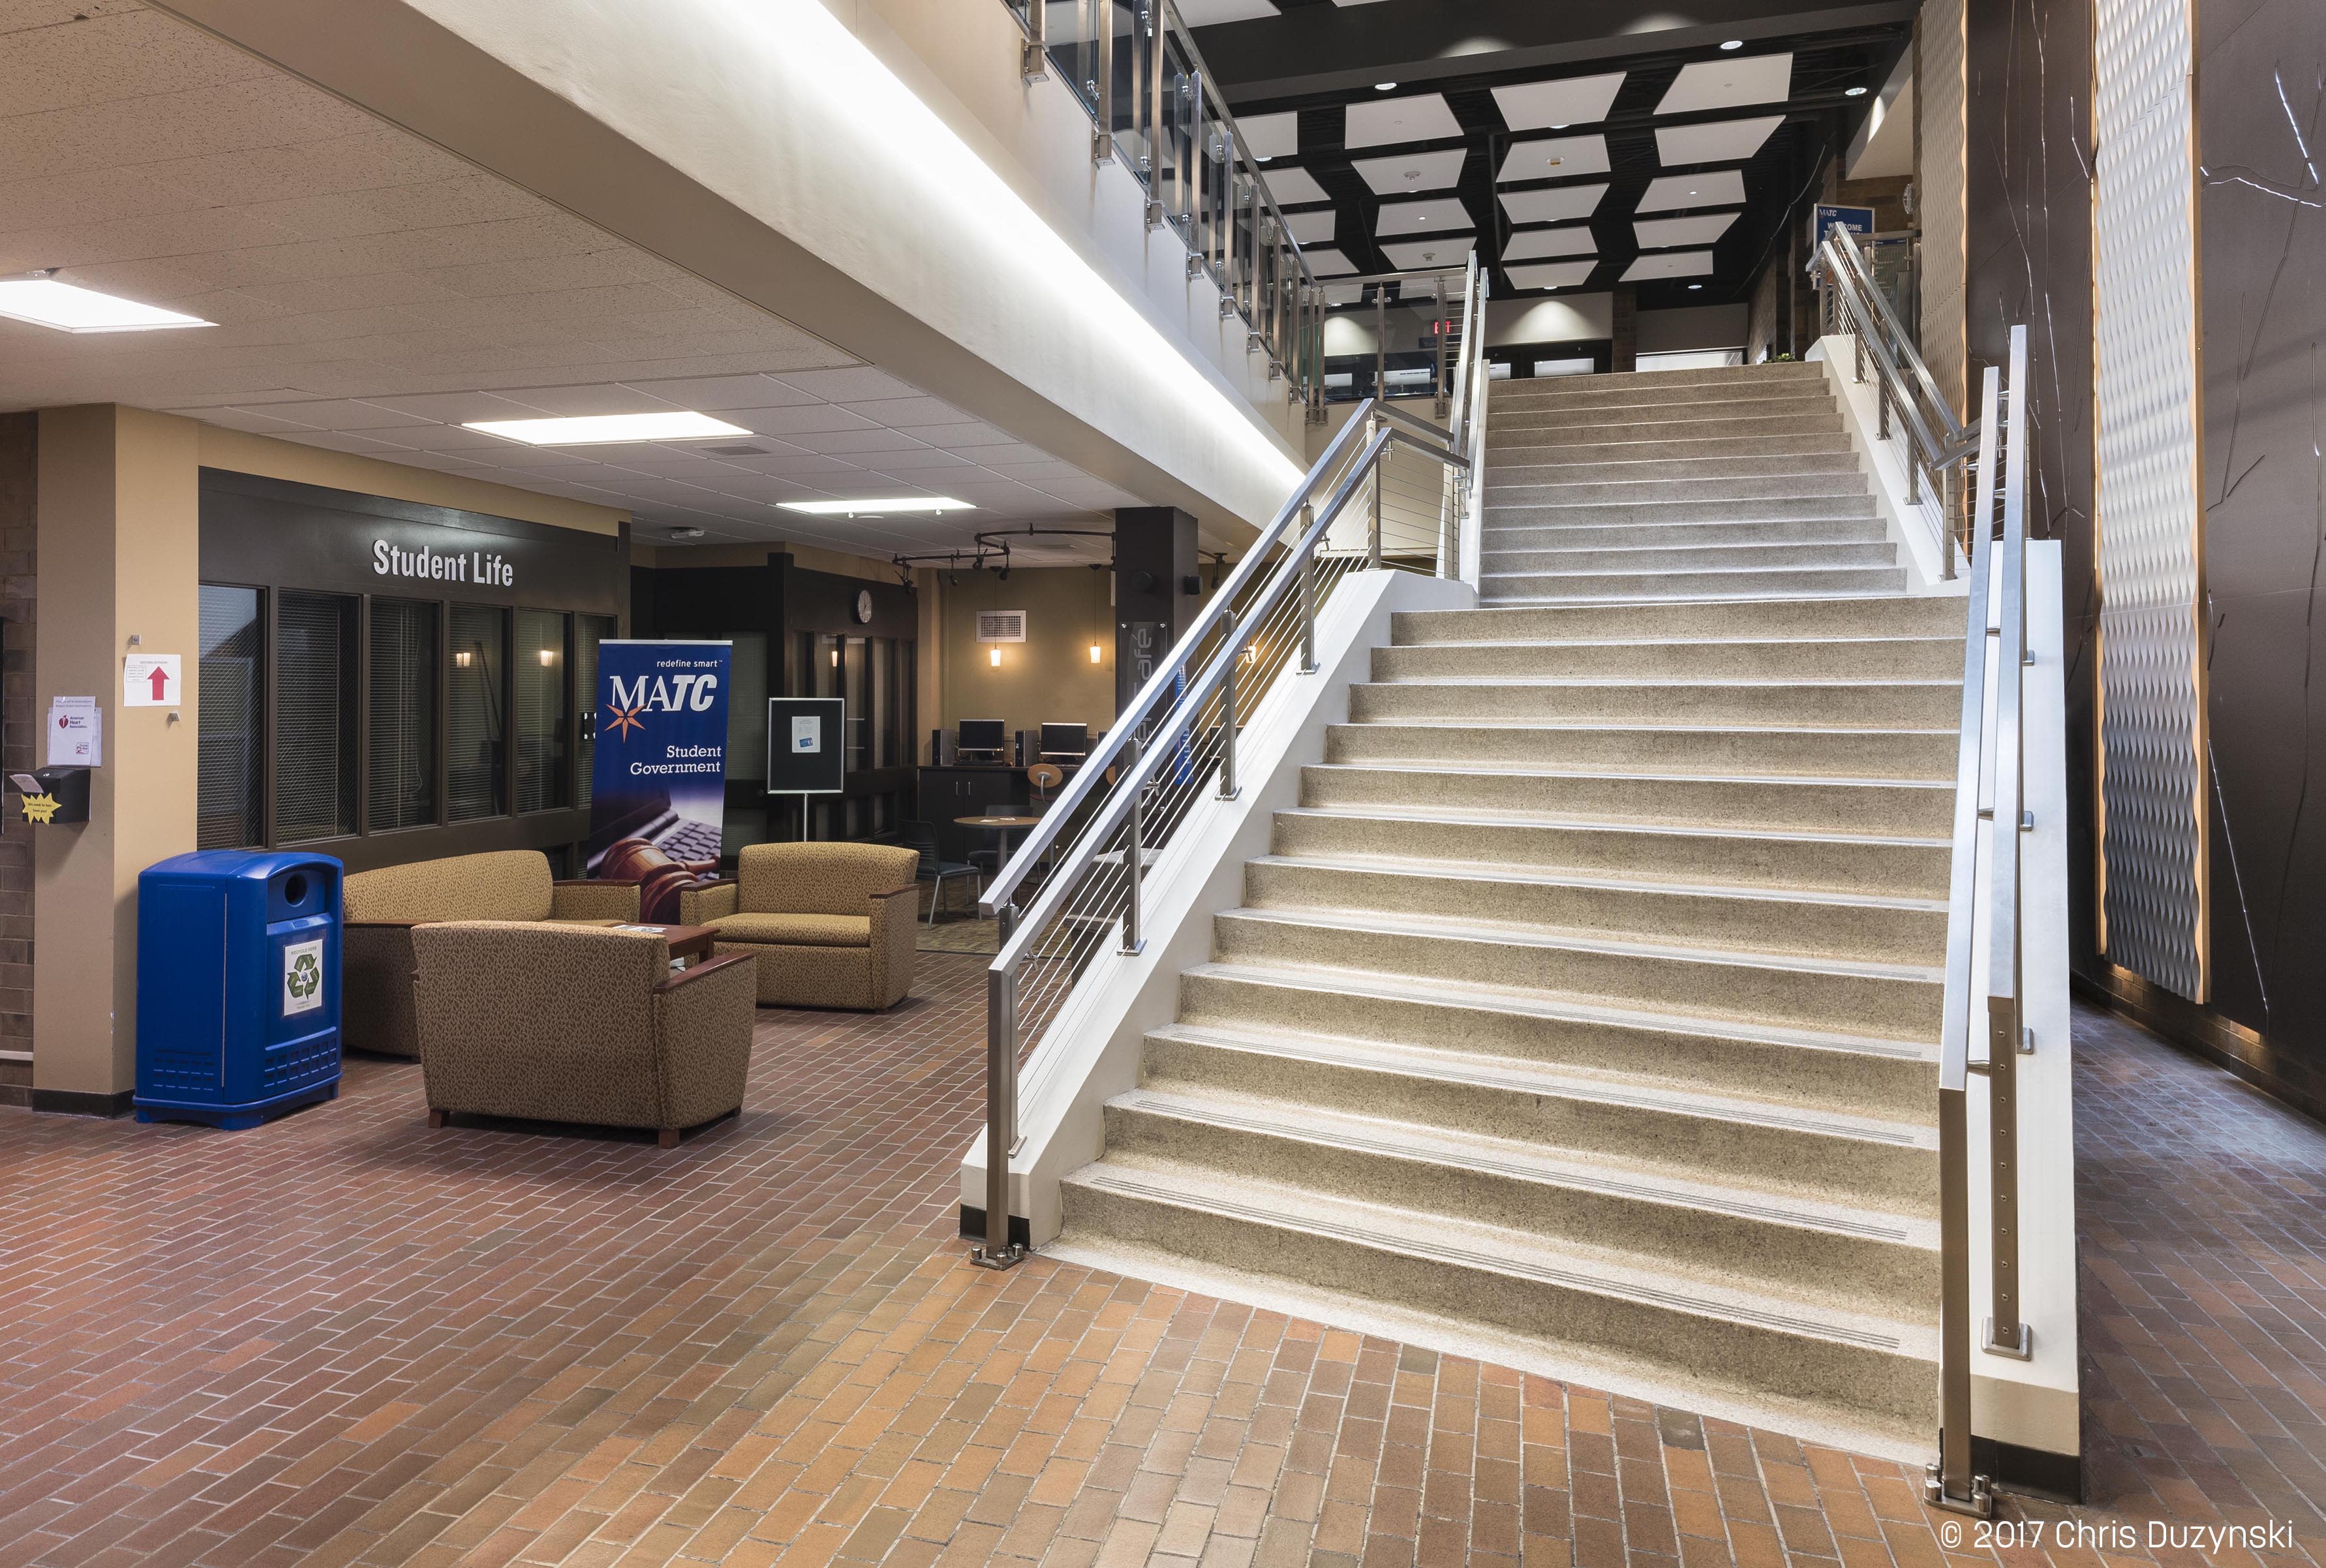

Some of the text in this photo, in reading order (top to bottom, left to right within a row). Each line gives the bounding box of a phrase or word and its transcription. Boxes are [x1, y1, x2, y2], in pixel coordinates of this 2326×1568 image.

[1828, 223, 1862, 231] WOME
[373, 539, 513, 587] Student Life
[656, 659, 691, 668] redefine
[609, 674, 717, 713] MATC
[667, 745, 722, 758] Student
[630, 761, 720, 775] Government
